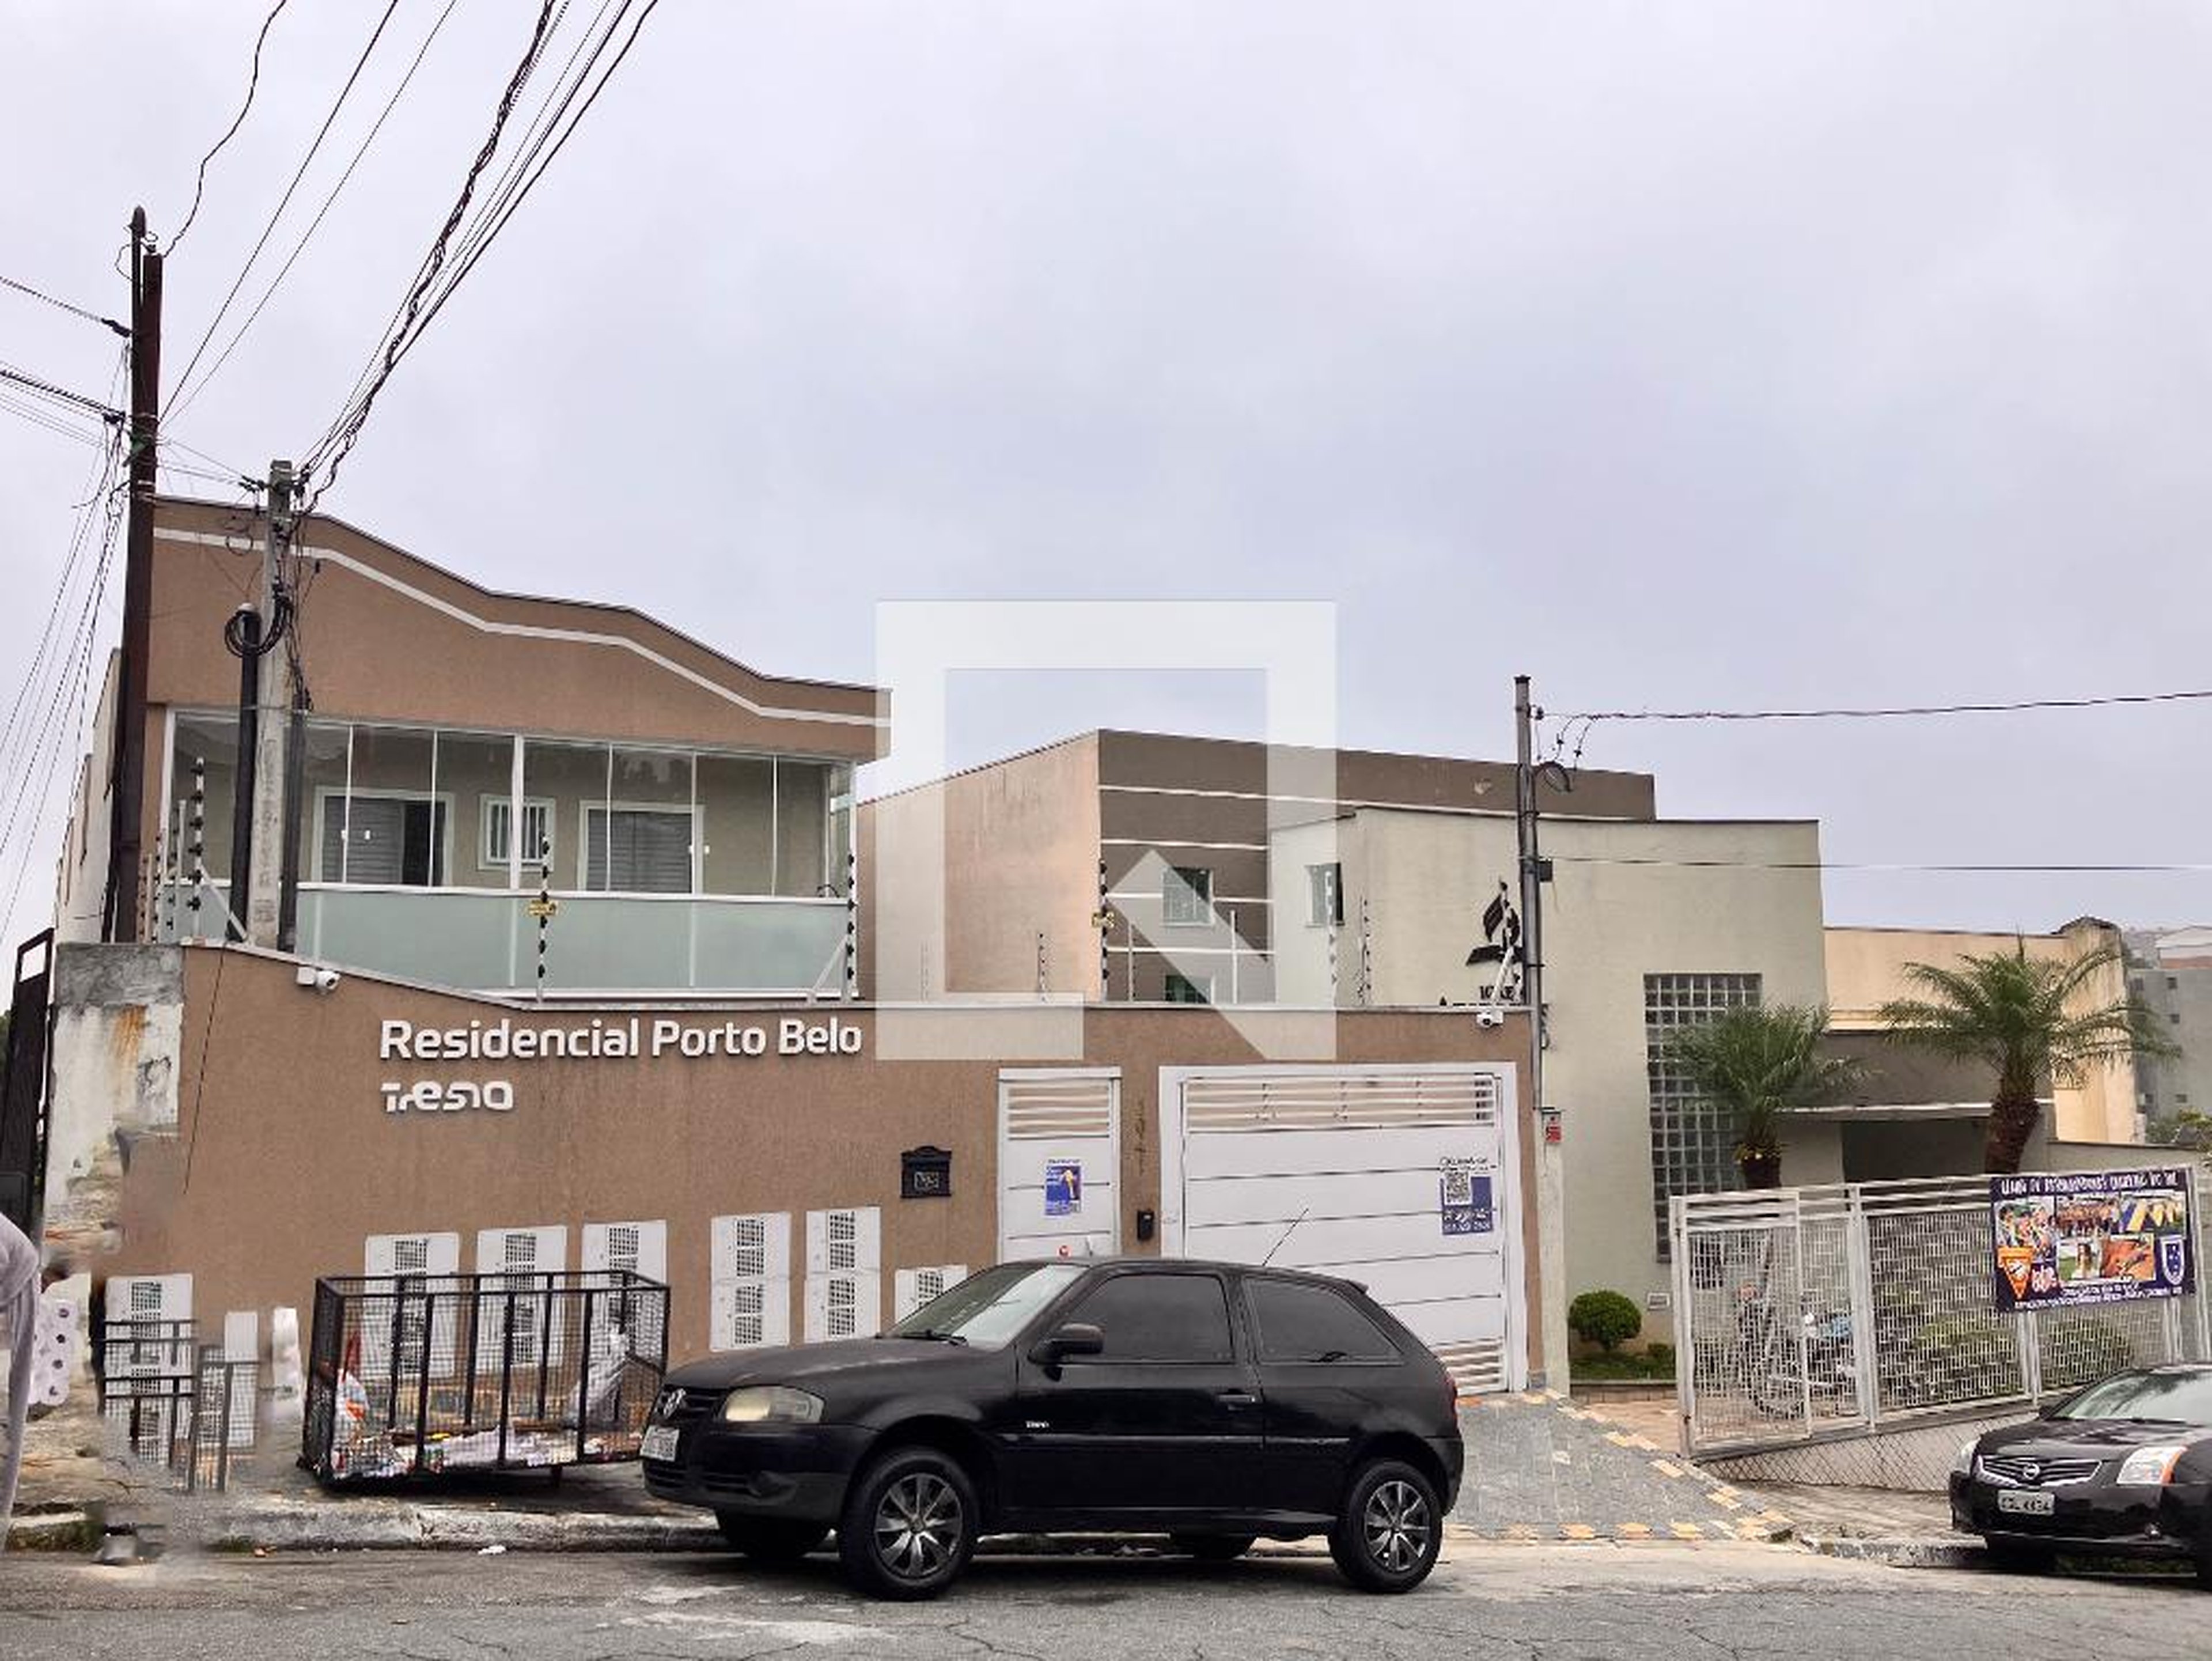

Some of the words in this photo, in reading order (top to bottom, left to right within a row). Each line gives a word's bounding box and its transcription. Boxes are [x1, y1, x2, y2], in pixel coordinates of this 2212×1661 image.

[380, 1019, 639, 1059] Residencial
[652, 1020, 766, 1057] Porto
[778, 1017, 862, 1054] Belo
